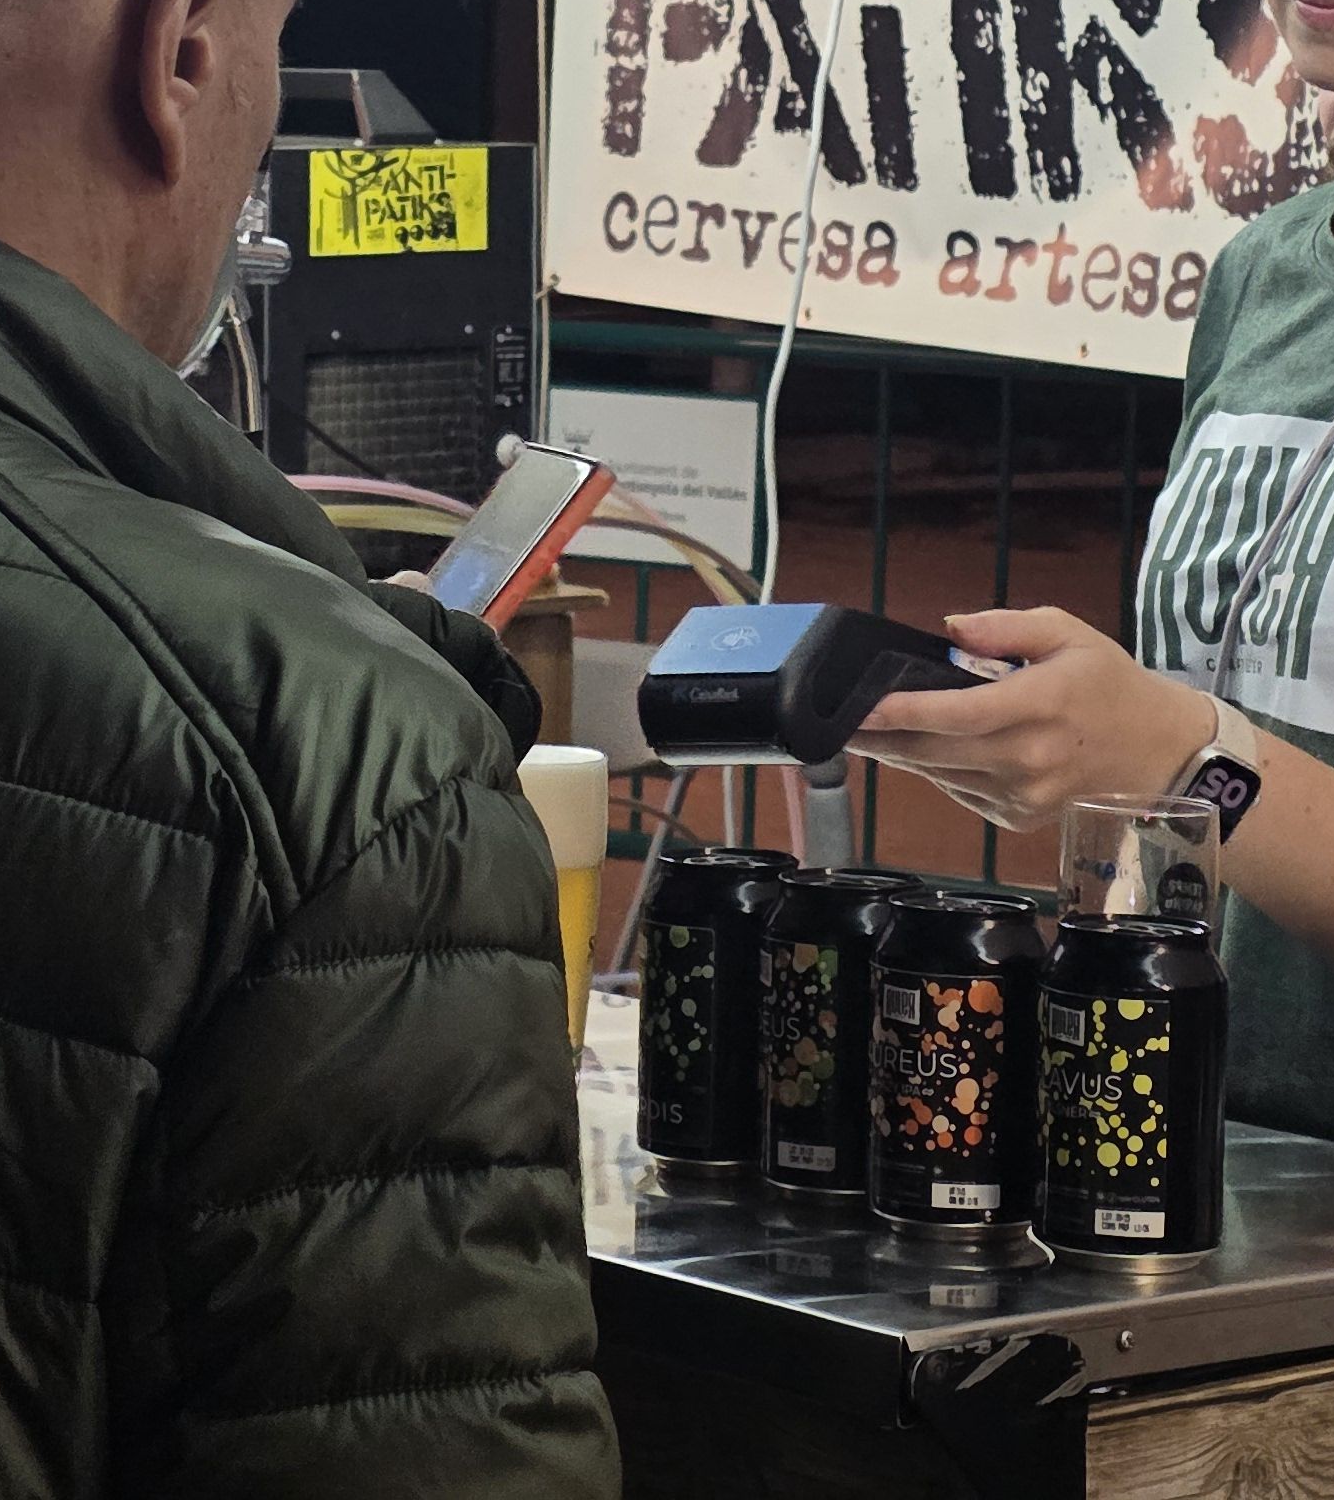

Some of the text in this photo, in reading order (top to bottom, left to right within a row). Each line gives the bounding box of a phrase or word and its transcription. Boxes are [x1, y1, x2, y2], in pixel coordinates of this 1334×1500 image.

[603, 190, 901, 289] cervesa
[761, 1010, 801, 1041] EUS
[868, 1040, 958, 1079] UREUS
